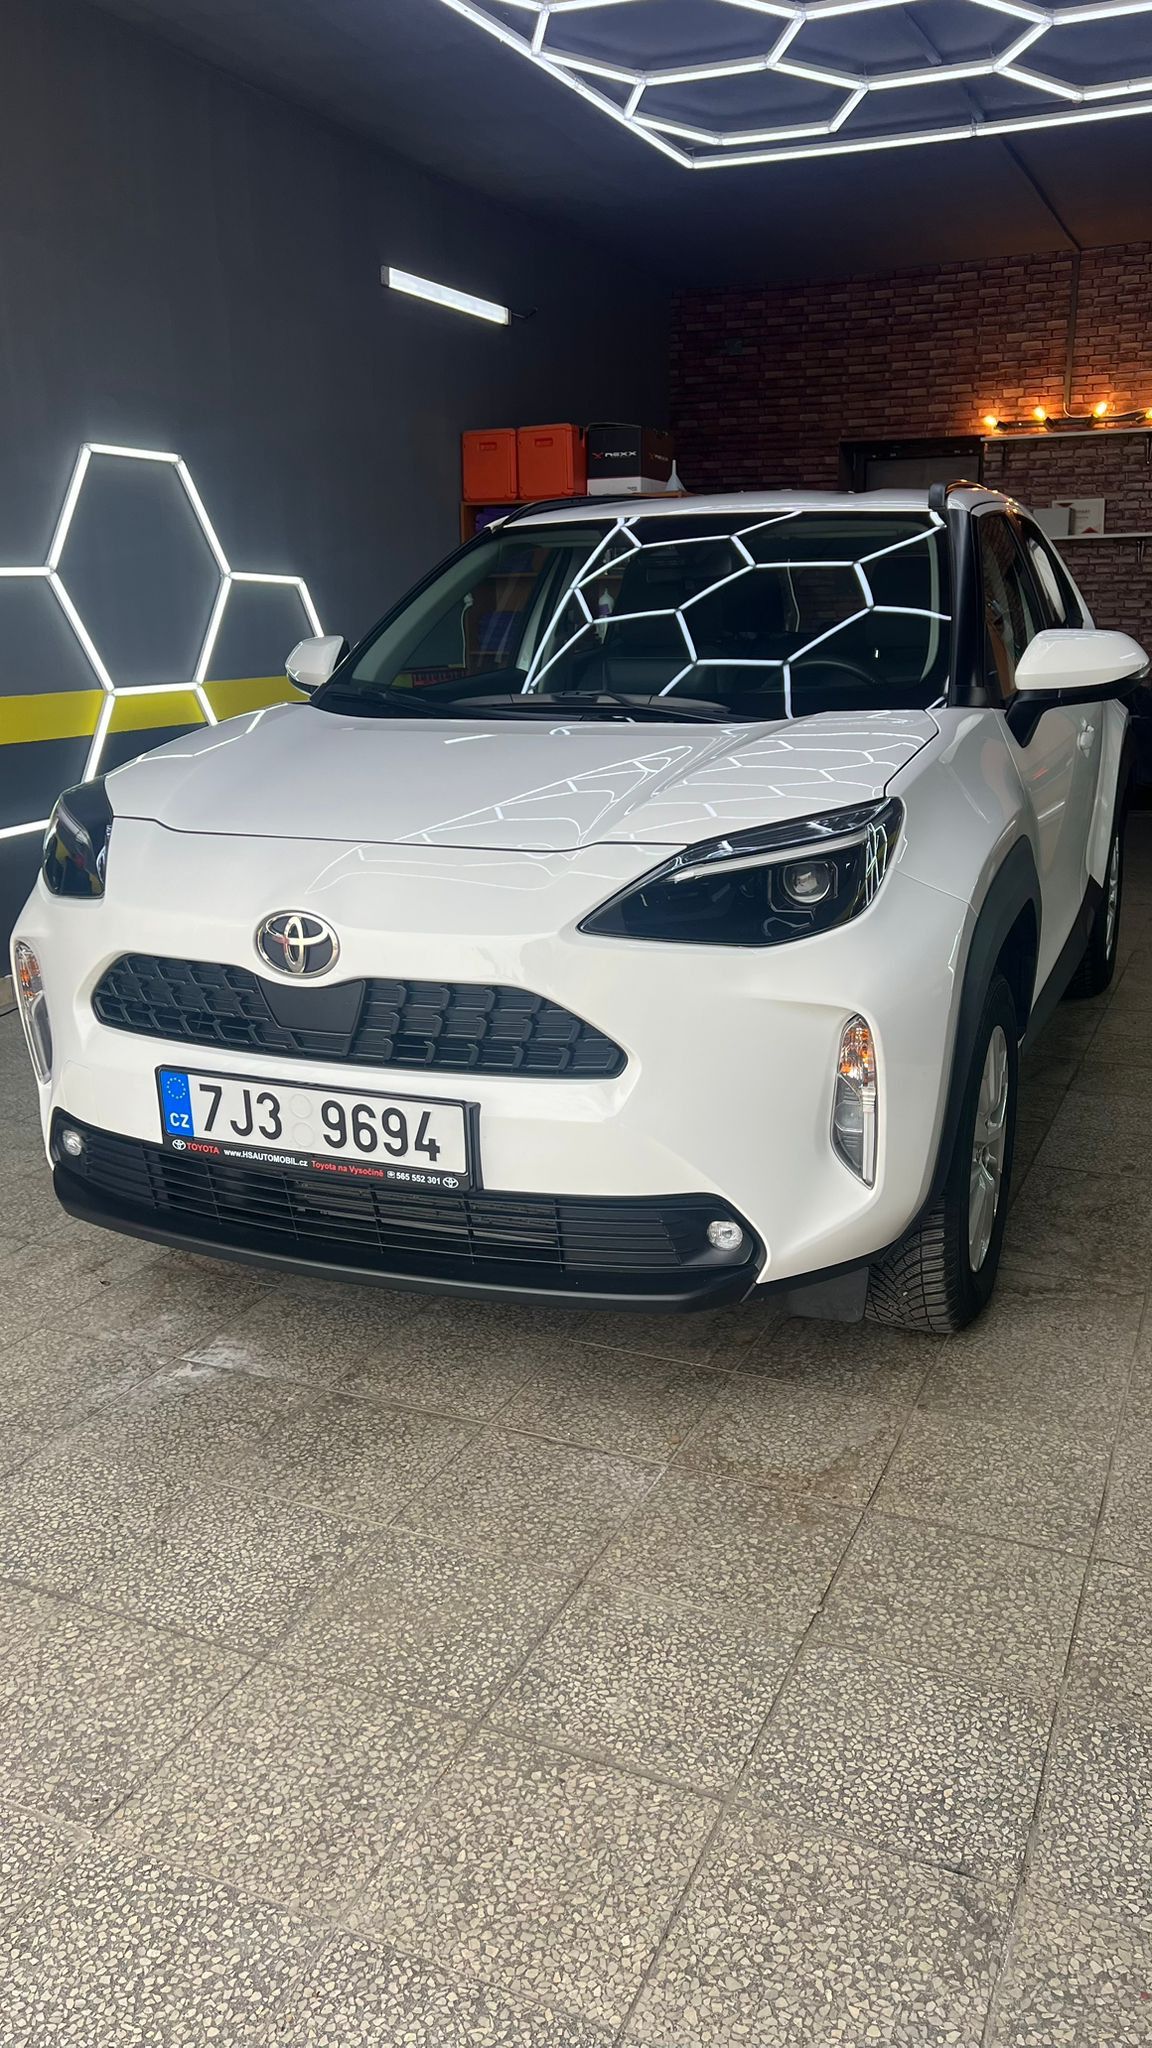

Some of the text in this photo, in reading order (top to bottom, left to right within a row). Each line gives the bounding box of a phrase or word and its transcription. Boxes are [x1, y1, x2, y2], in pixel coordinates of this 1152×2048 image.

[169, 1111, 191, 1129] CZ
[199, 1083, 441, 1162] 7J3 9694
[186, 1141, 441, 1185] TOYOTA www.HSAUTOMOBIL.cz Toyota na Vysočině 565 552 301
